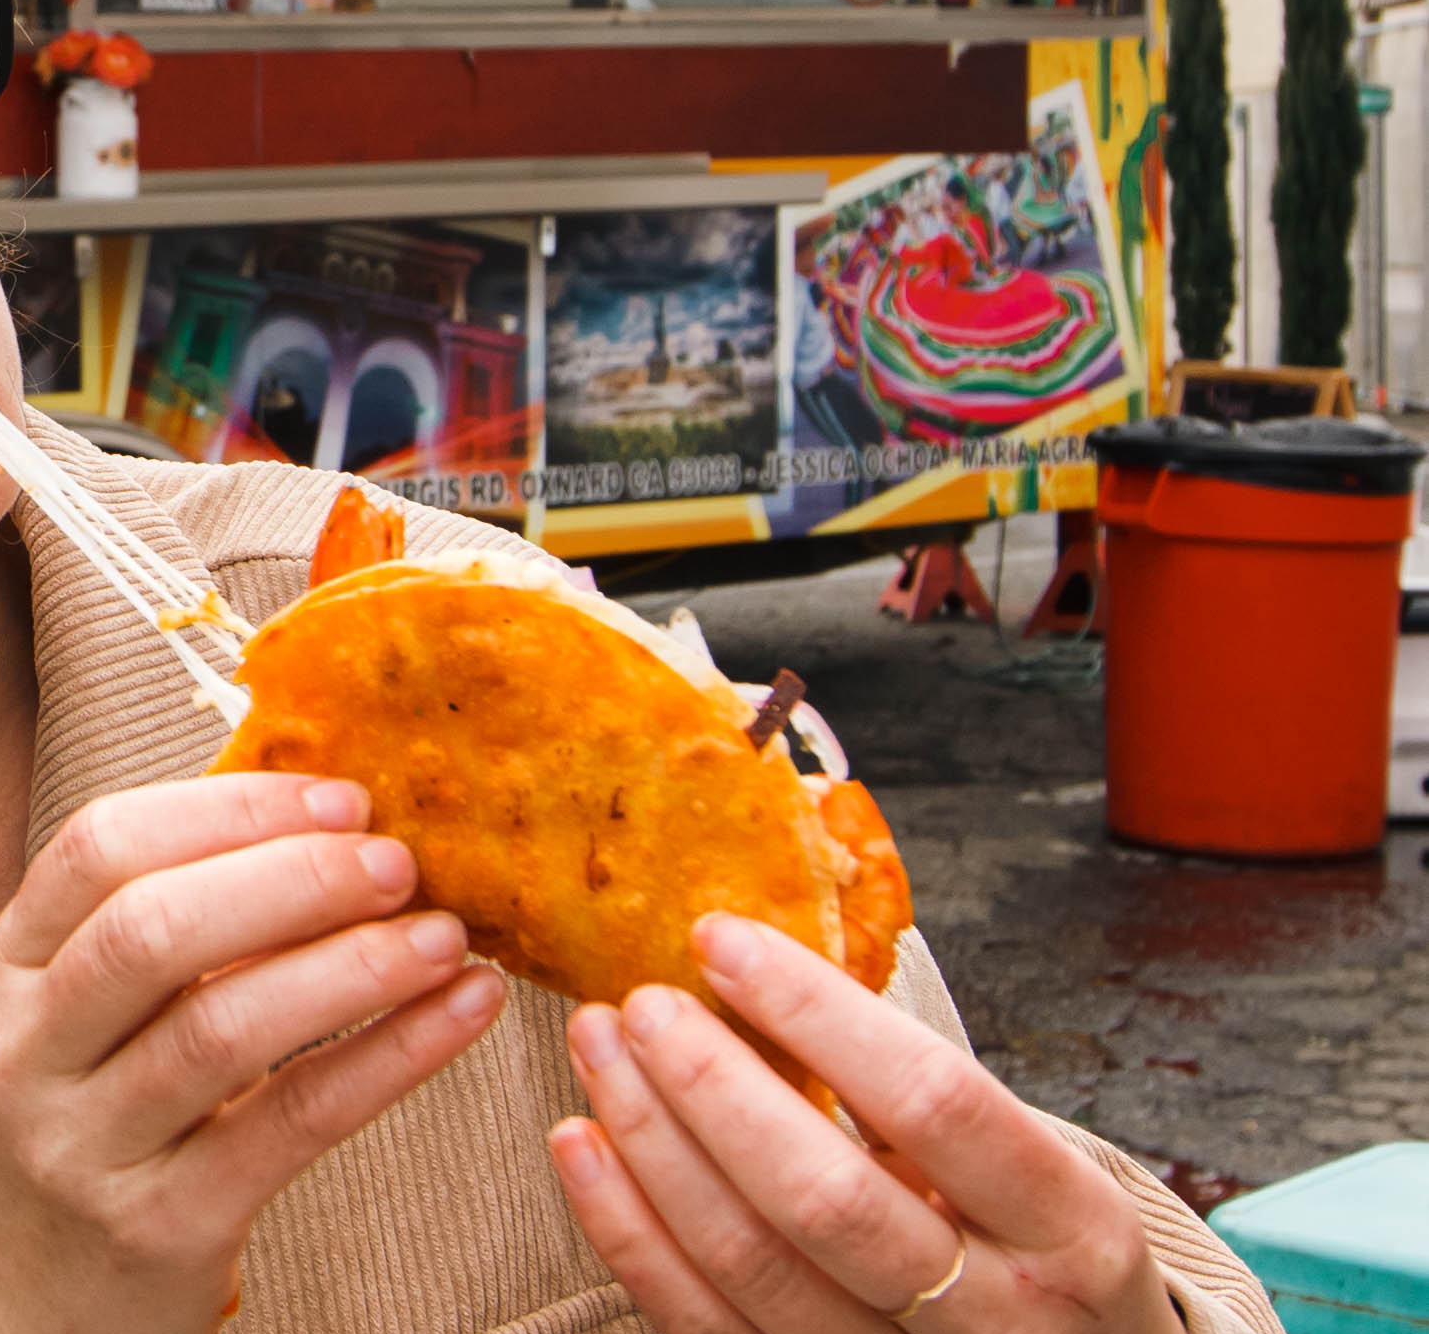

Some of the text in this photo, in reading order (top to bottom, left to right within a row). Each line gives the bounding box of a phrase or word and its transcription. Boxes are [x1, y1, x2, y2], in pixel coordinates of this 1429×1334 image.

[471, 471, 510, 508] RD.
[520, 461, 623, 505] OXNARD
[627, 456, 668, 501] CA
[759, 446, 858, 490] JESSICA
[863, 441, 944, 482] OCHOA
[960, 434, 1031, 467] MARIA
